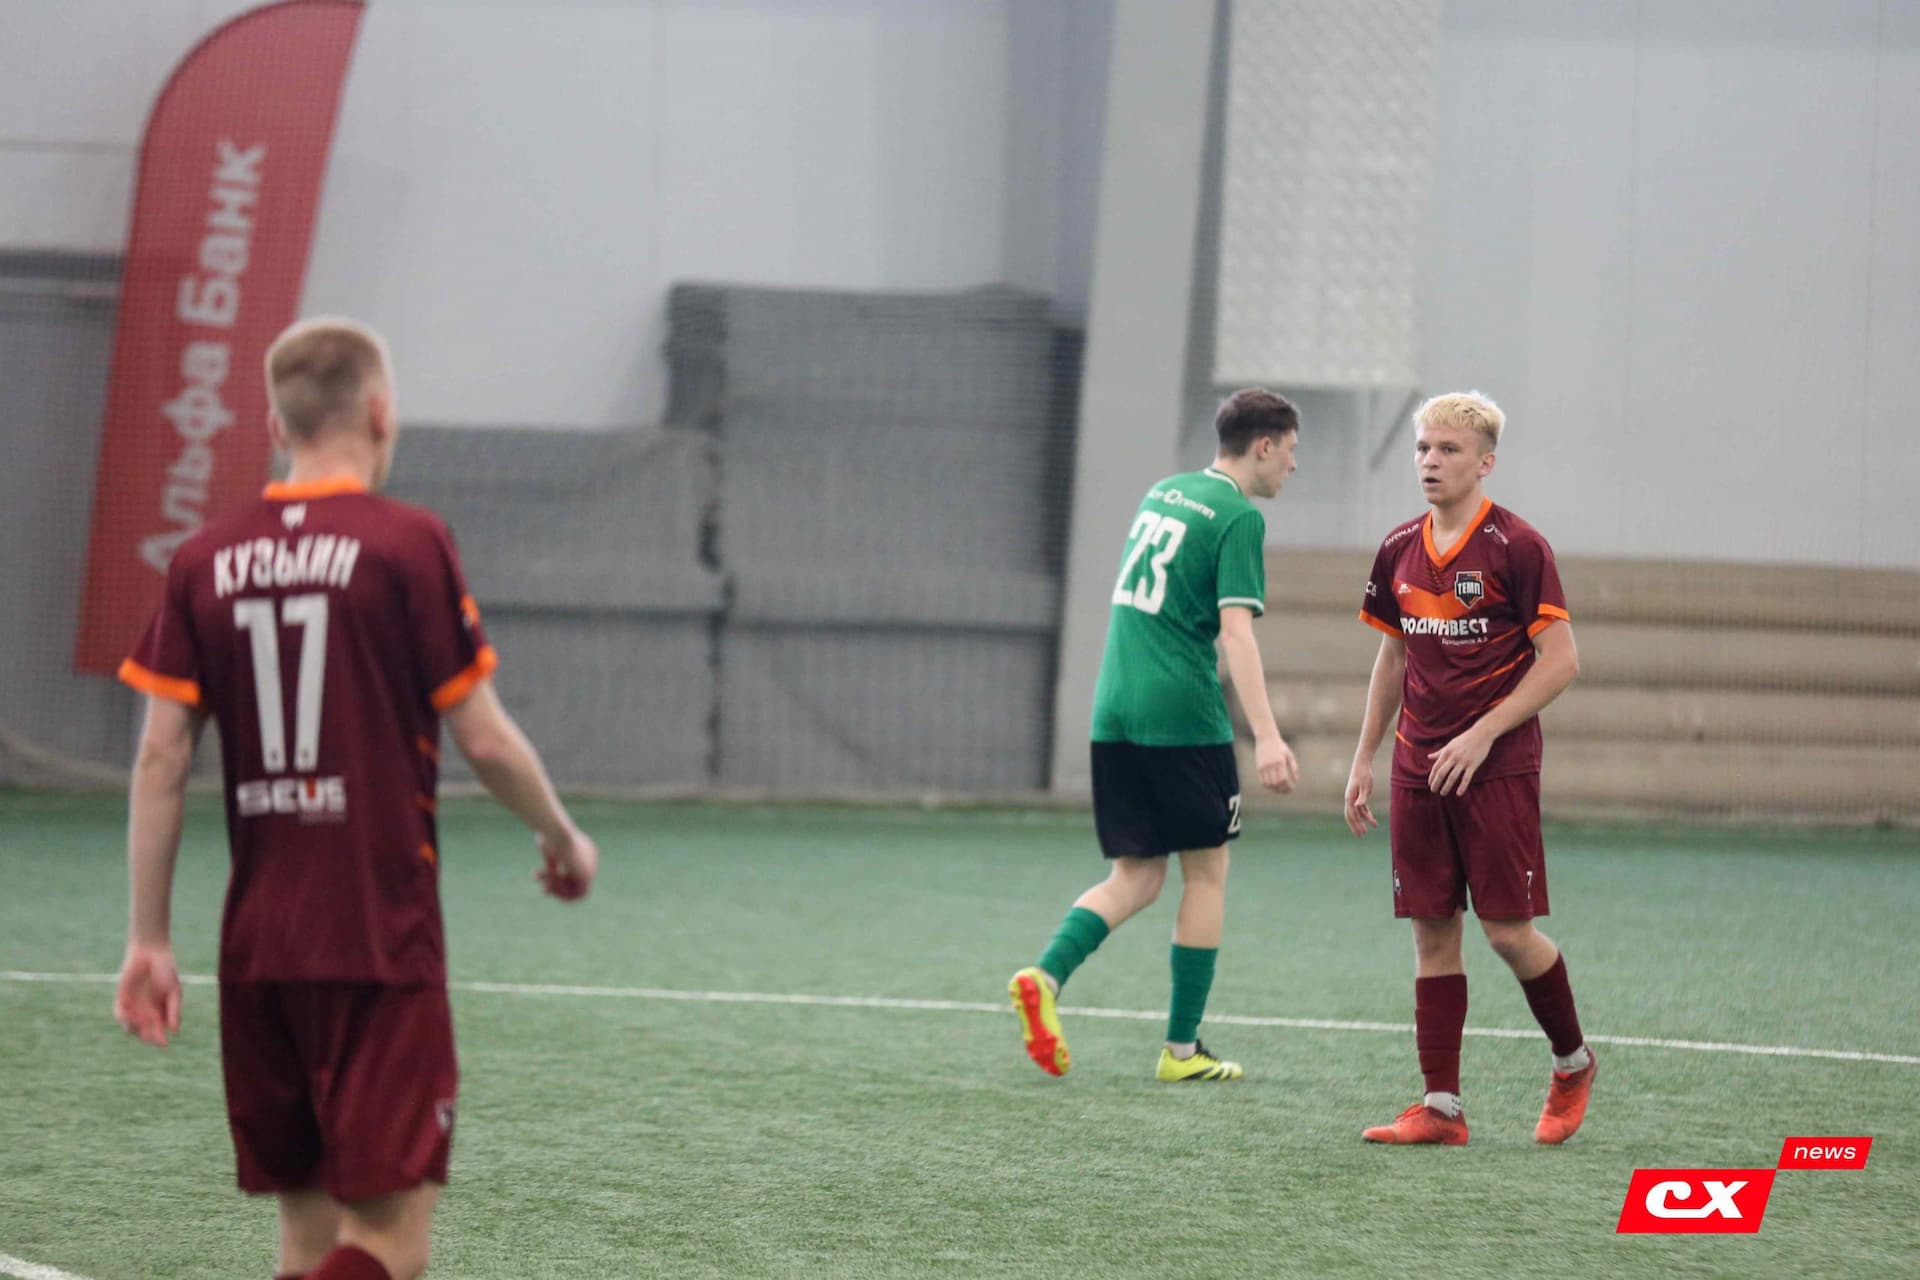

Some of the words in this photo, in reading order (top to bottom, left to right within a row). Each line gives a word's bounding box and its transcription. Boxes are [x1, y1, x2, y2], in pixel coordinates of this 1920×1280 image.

[176, 138, 268, 328] Банк
[213, 534, 361, 597] КУЗЬКИН
[1111, 509, 1187, 616] 23
[1457, 581, 1481, 596] ТЕМП
[233, 593, 329, 773] 17
